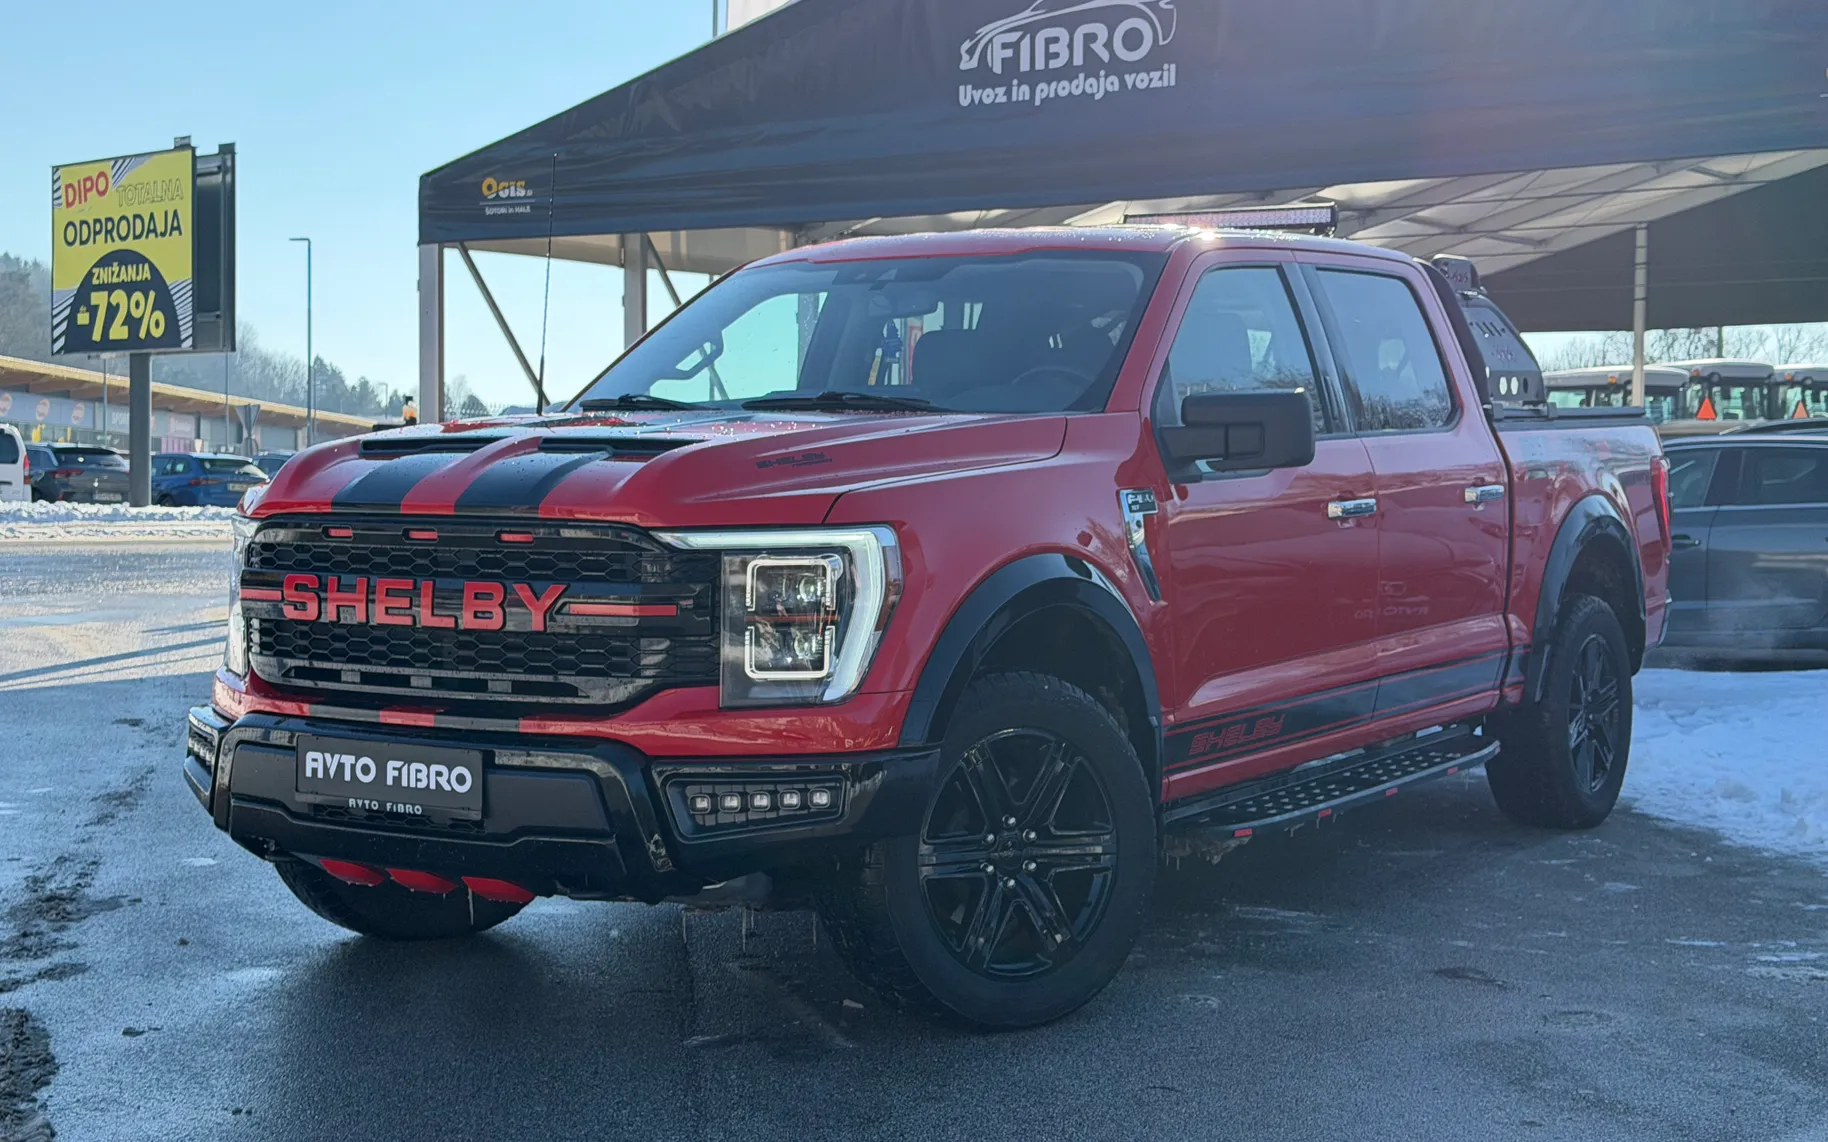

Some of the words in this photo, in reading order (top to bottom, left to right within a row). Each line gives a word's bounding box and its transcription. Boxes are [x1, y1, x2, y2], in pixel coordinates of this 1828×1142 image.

[992, 17, 1154, 75] FIBRO
[958, 84, 1008, 107] Uvoz
[1012, 78, 1031, 102] in
[1034, 69, 1120, 106] prodaja
[1124, 63, 1177, 91] vozil
[64, 171, 109, 208] DIPO
[116, 178, 184, 208] TOTALNA
[63, 208, 183, 247] ODPRODAJA
[91, 261, 152, 285] ZNIŽANJA
[282, 573, 568, 633] SHELBY
[1187, 713, 1287, 757] SHELBY
[305, 751, 377, 783] AVTO
[386, 759, 473, 793] FIBRO
[348, 798, 379, 811] AVTO
[386, 802, 423, 815] FIBRO
